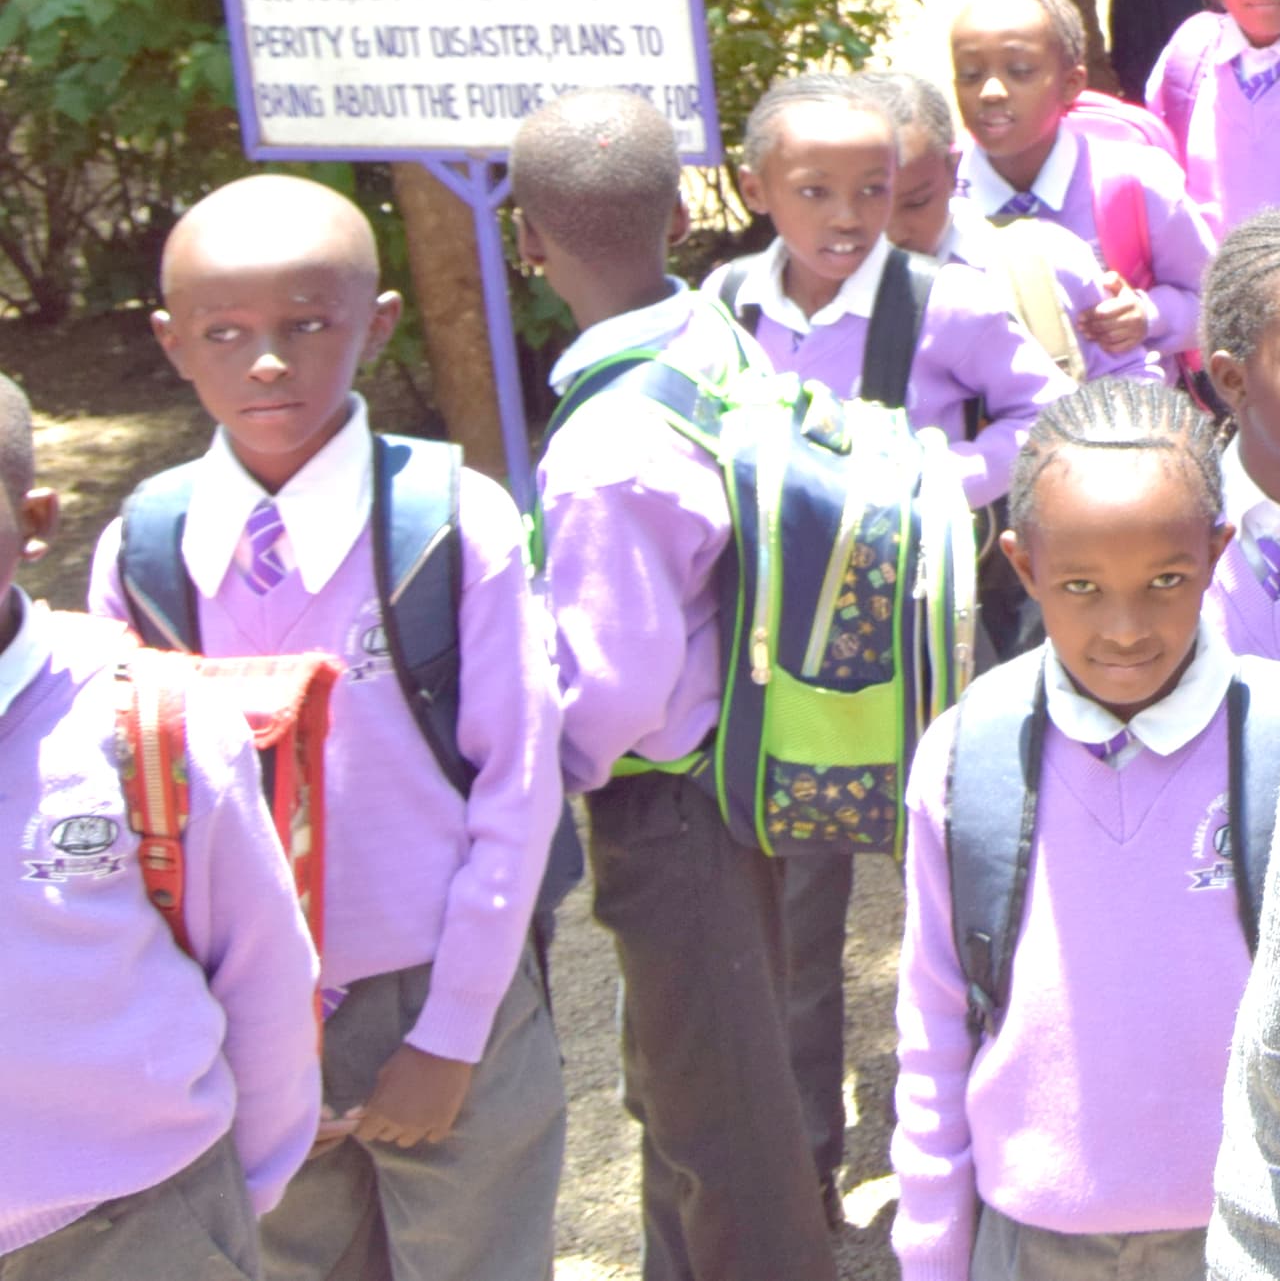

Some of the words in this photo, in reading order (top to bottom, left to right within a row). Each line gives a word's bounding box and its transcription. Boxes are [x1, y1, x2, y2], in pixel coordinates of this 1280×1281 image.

[252, 25, 343, 59] PERITY
[375, 25, 421, 58] NOT
[630, 24, 664, 57] TO
[257, 82, 326, 119] BRING
[333, 82, 409, 118] ABOUT
[411, 82, 462, 120] THE
[466, 82, 543, 119] FUTURE
[663, 83, 702, 121] FOR
